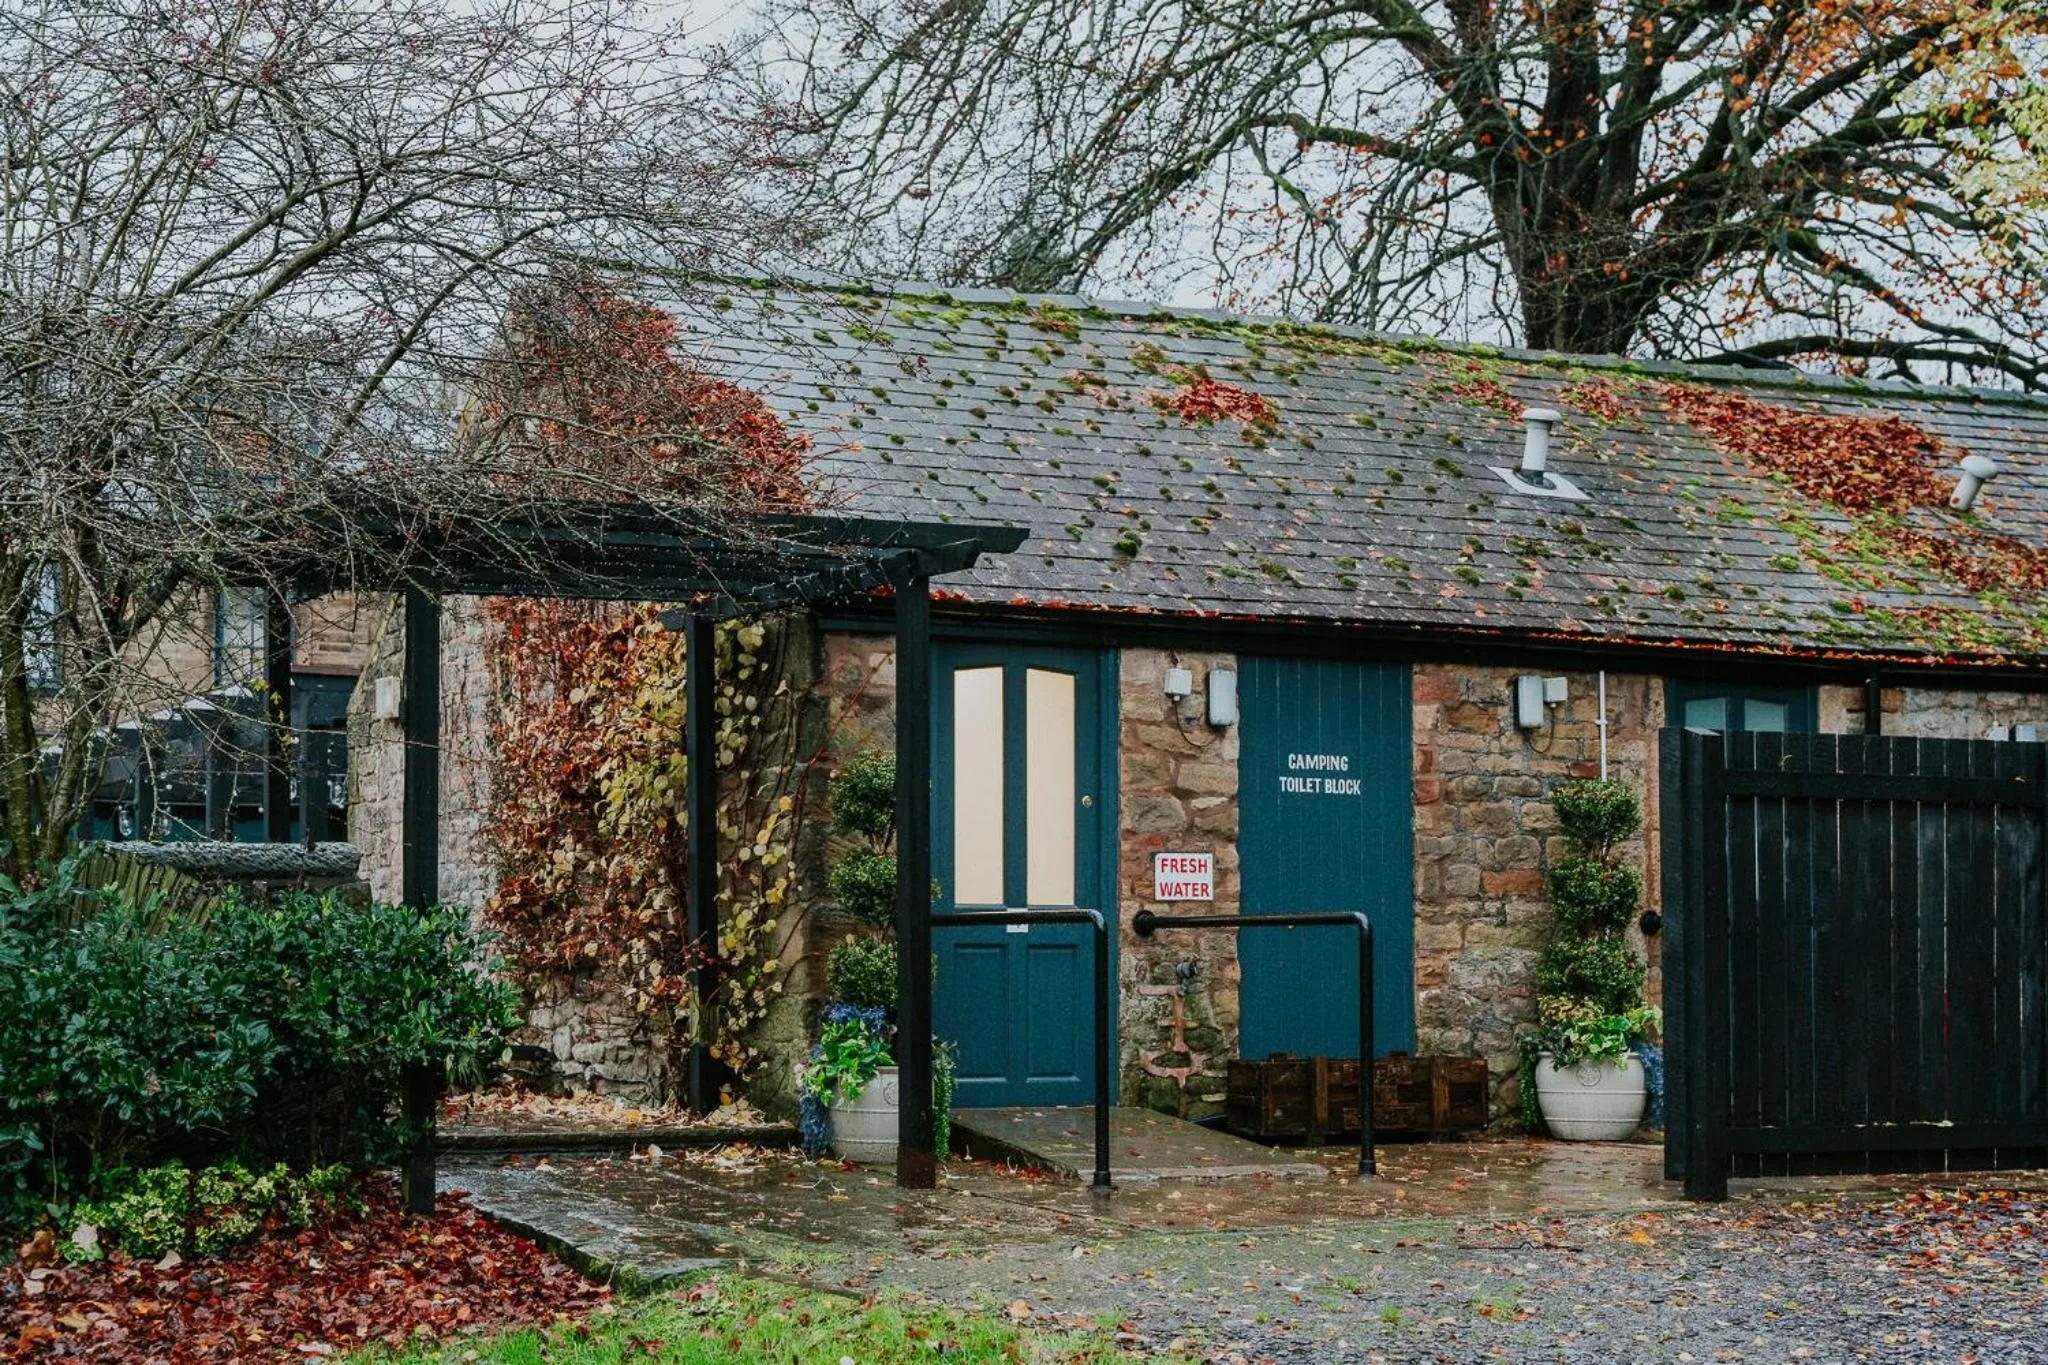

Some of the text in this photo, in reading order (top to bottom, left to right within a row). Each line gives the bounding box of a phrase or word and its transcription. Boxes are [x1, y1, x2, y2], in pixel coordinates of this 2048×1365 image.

[1288, 753, 1349, 771] CAMPING
[1279, 776, 1361, 795] TOILET BLOCK
[1161, 858, 1208, 873] FRESH
[1160, 882, 1209, 897] WATER
